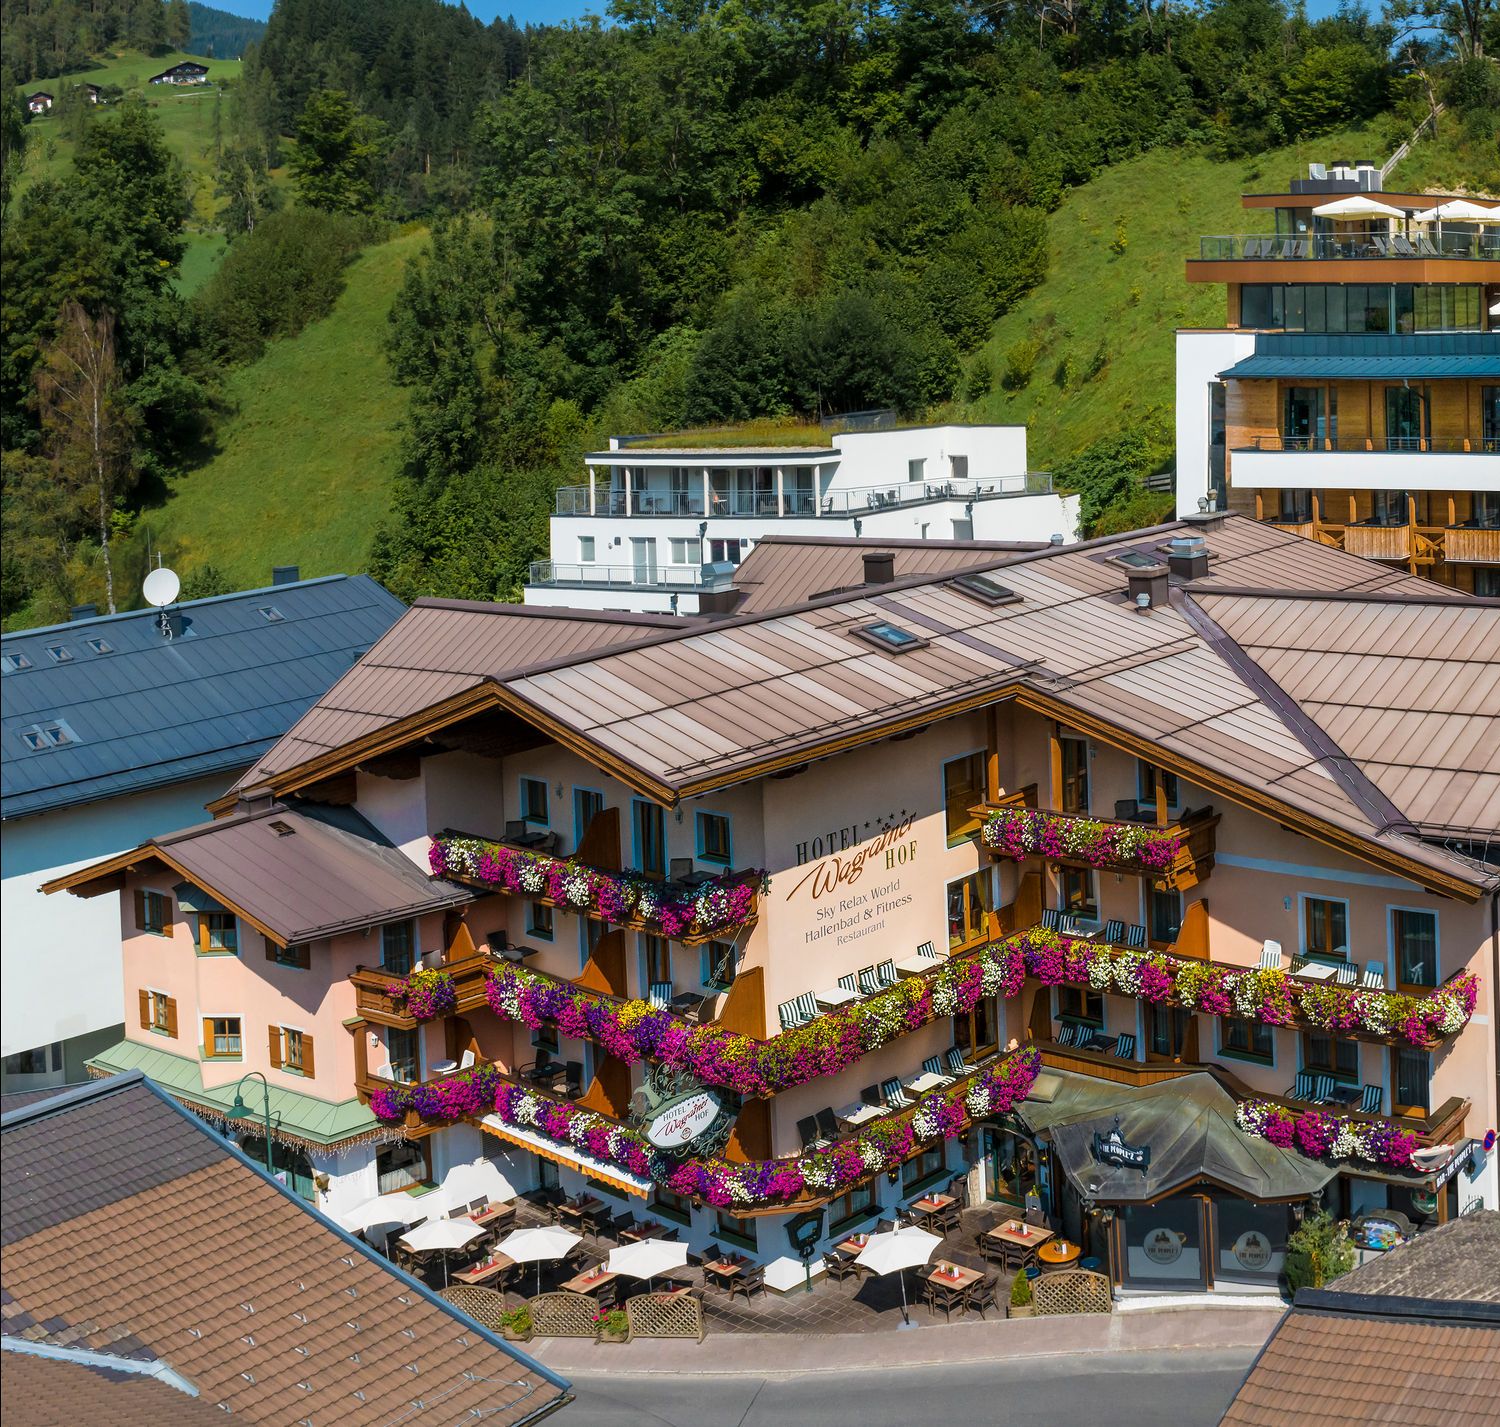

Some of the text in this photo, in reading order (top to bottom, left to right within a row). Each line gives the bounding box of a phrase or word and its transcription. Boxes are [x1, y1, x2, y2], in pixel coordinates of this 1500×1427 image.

[786, 812, 917, 902] Wagrainer
[795, 825, 862, 867] HOTEL
[885, 840, 918, 870] HOF
[816, 879, 901, 921] Sky Relax World
[805, 894, 913, 943] Hallenbad & Fitness
[837, 920, 886, 946] Restaurant
[662, 1106, 687, 1121] HOTEL
[694, 1109, 709, 1121] HOF
